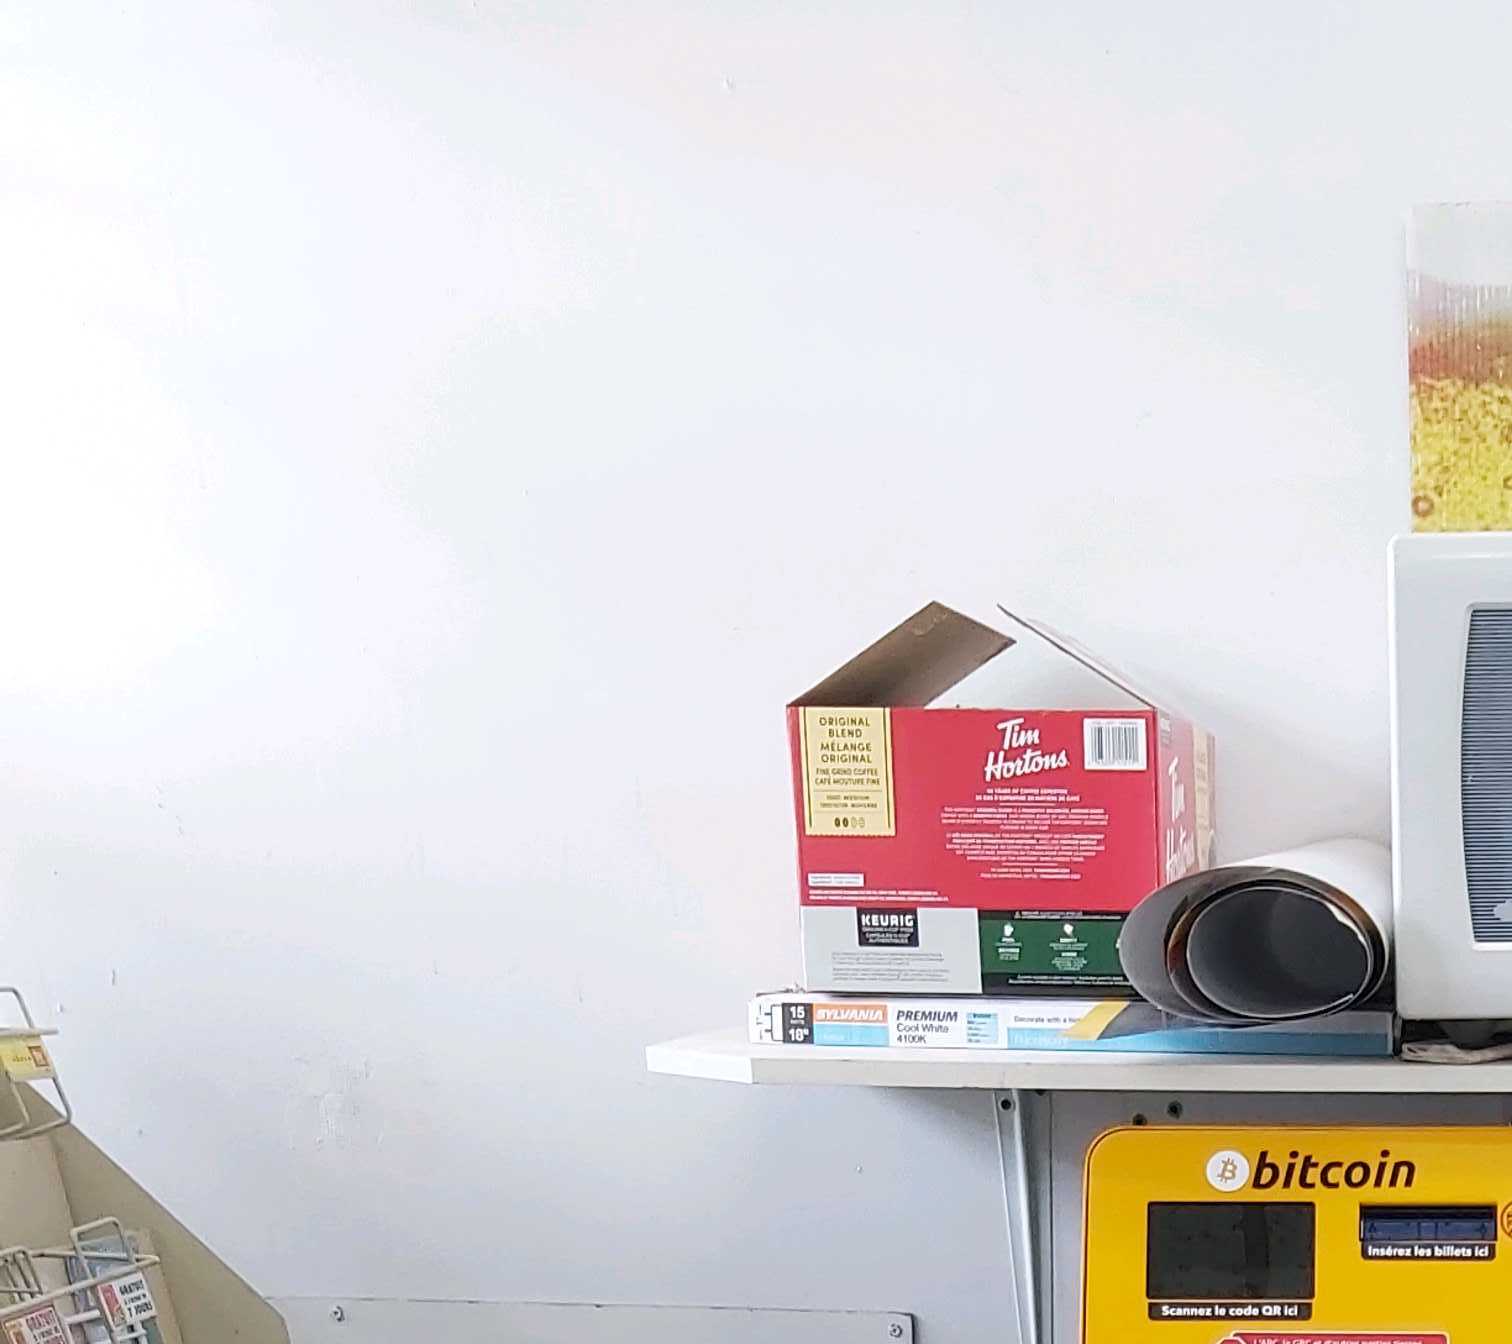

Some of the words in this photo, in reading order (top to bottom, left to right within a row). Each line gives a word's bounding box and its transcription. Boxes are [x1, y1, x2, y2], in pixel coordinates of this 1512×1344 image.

[819, 717, 871, 727] ORIGINAL
[828, 728, 863, 738] BLEND
[997, 717, 1040, 750] Tim
[821, 754, 872, 764] ORIGINAL
[984, 750, 1069, 782] Hortons
[861, 914, 914, 926] KEURIG
[816, 1008, 883, 1021] SYLVANIA
[896, 1010, 958, 1022] PREMIUM
[896, 1023, 920, 1033] Cool
[921, 1023, 950, 1033] White
[896, 1034, 927, 1044] 4100K
[1252, 1149, 1417, 1190] bitcoin
[1367, 1245, 1411, 1257] Insérez
[1414, 1245, 1432, 1257] les
[1434, 1245, 1472, 1257] billets
[1475, 1245, 1489, 1257] ici
[1161, 1305, 1212, 1317] Scannez
[1214, 1305, 1227, 1317] le
[1228, 1305, 1258, 1317] code
[1261, 1305, 1281, 1318] QR
[1283, 1305, 1298, 1317] ici
